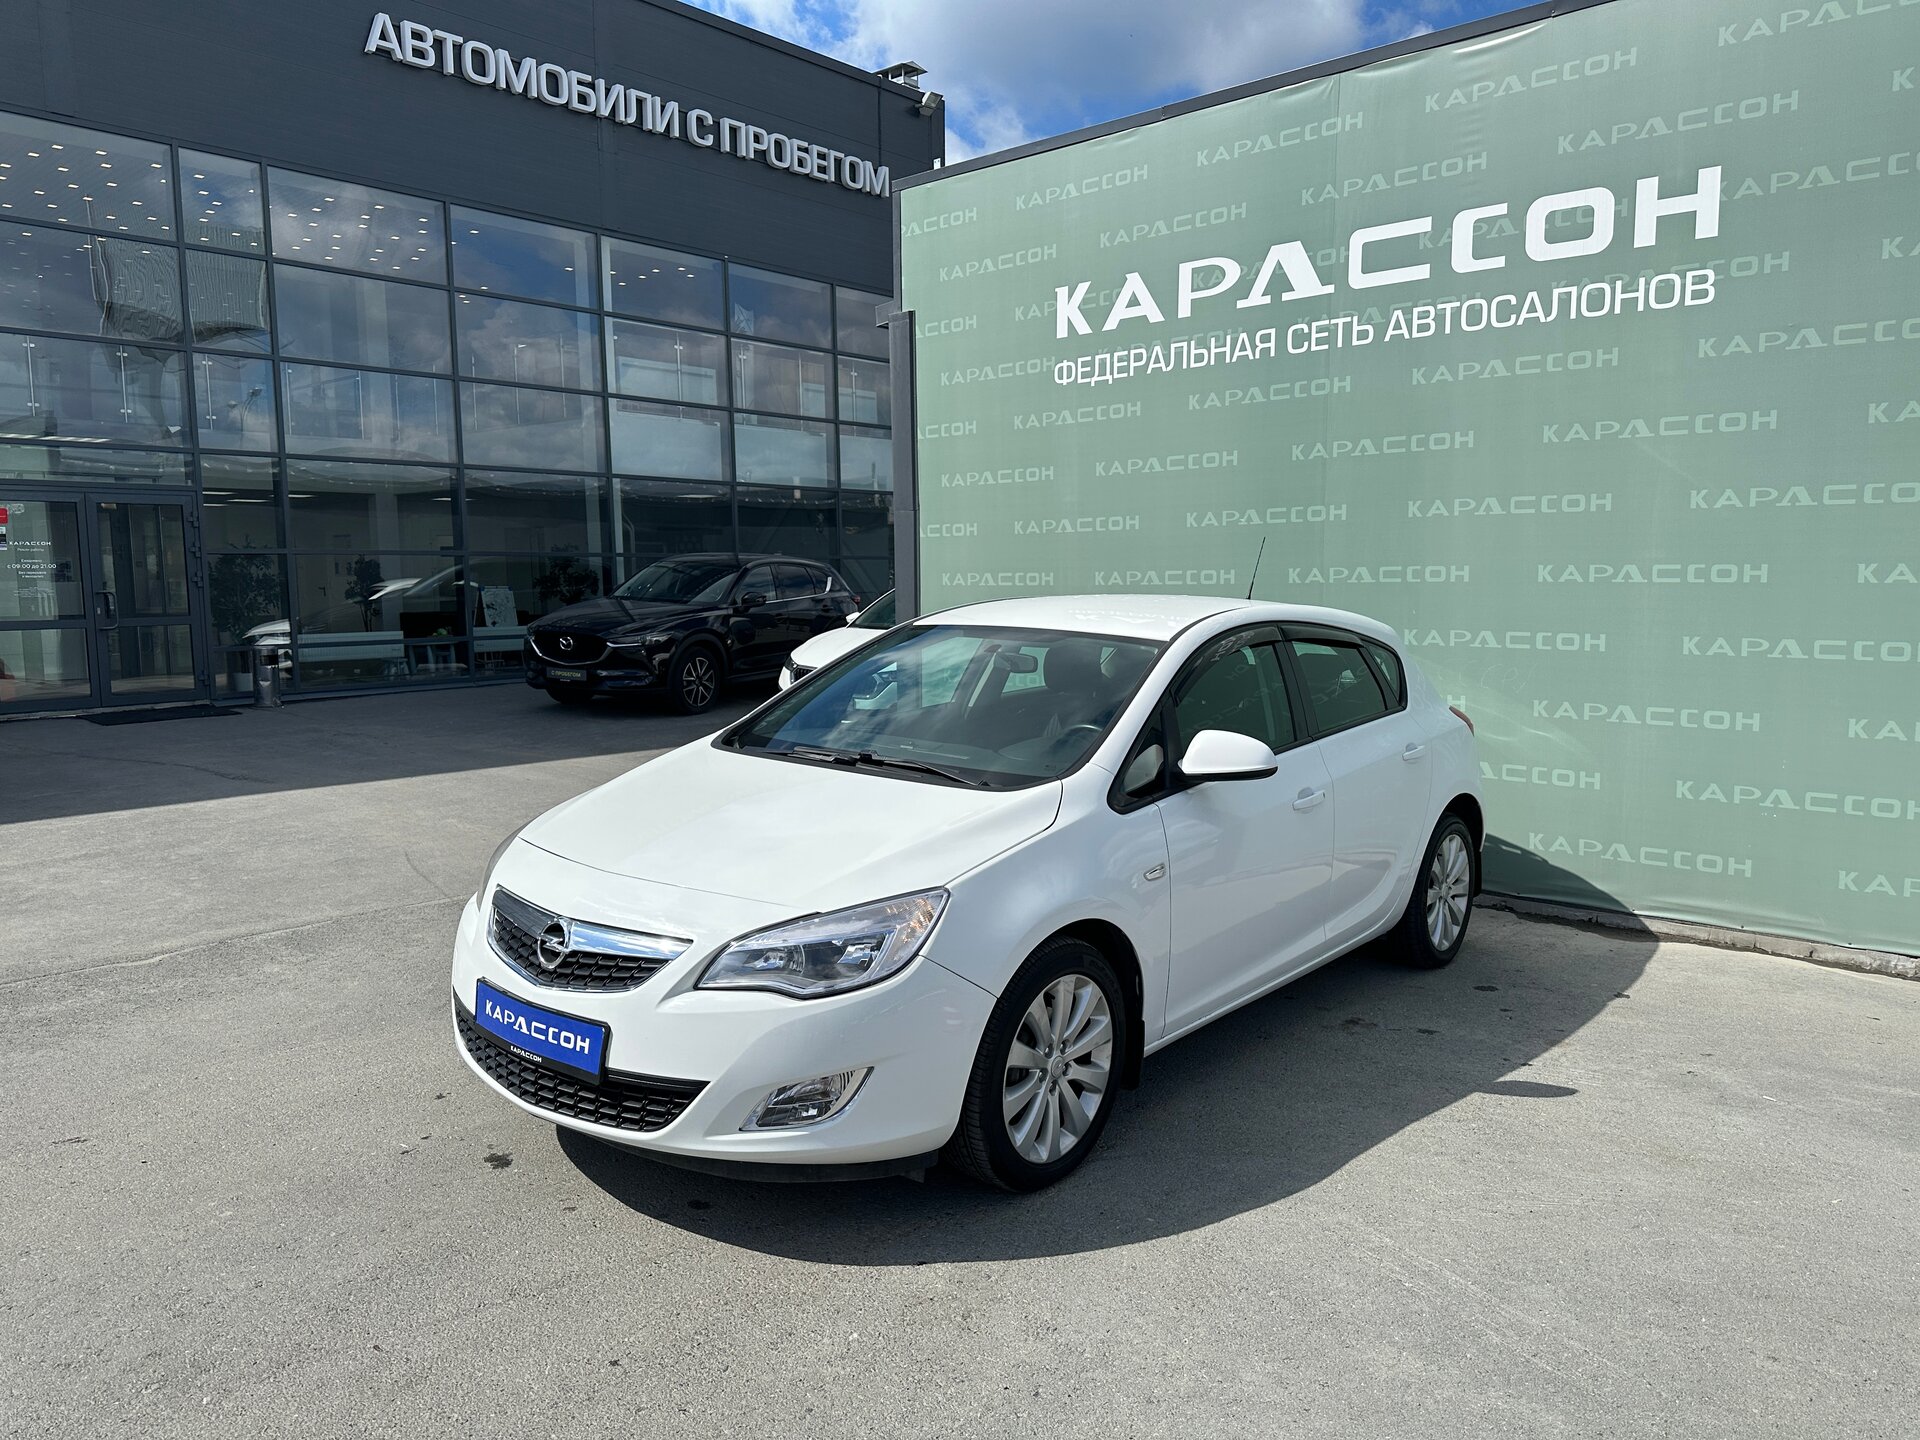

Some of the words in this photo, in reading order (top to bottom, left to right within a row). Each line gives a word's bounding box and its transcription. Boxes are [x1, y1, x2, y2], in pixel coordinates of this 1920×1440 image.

[364, 12, 679, 138] АВТОМОБИЛИ
[687, 108, 714, 147] С
[720, 117, 889, 198] ПРОБЕГОМ
[1055, 165, 1721, 338] КАРАССОН
[1054, 328, 1276, 387] ФЕДЕРАЛЬНАЯ
[1286, 316, 1374, 354] СЕТЬ
[1383, 269, 1716, 342] АВТОСАЛОНОВ
[1682, 636, 1920, 662] КАРАССО
[485, 999, 590, 1055] КАРАССОН
